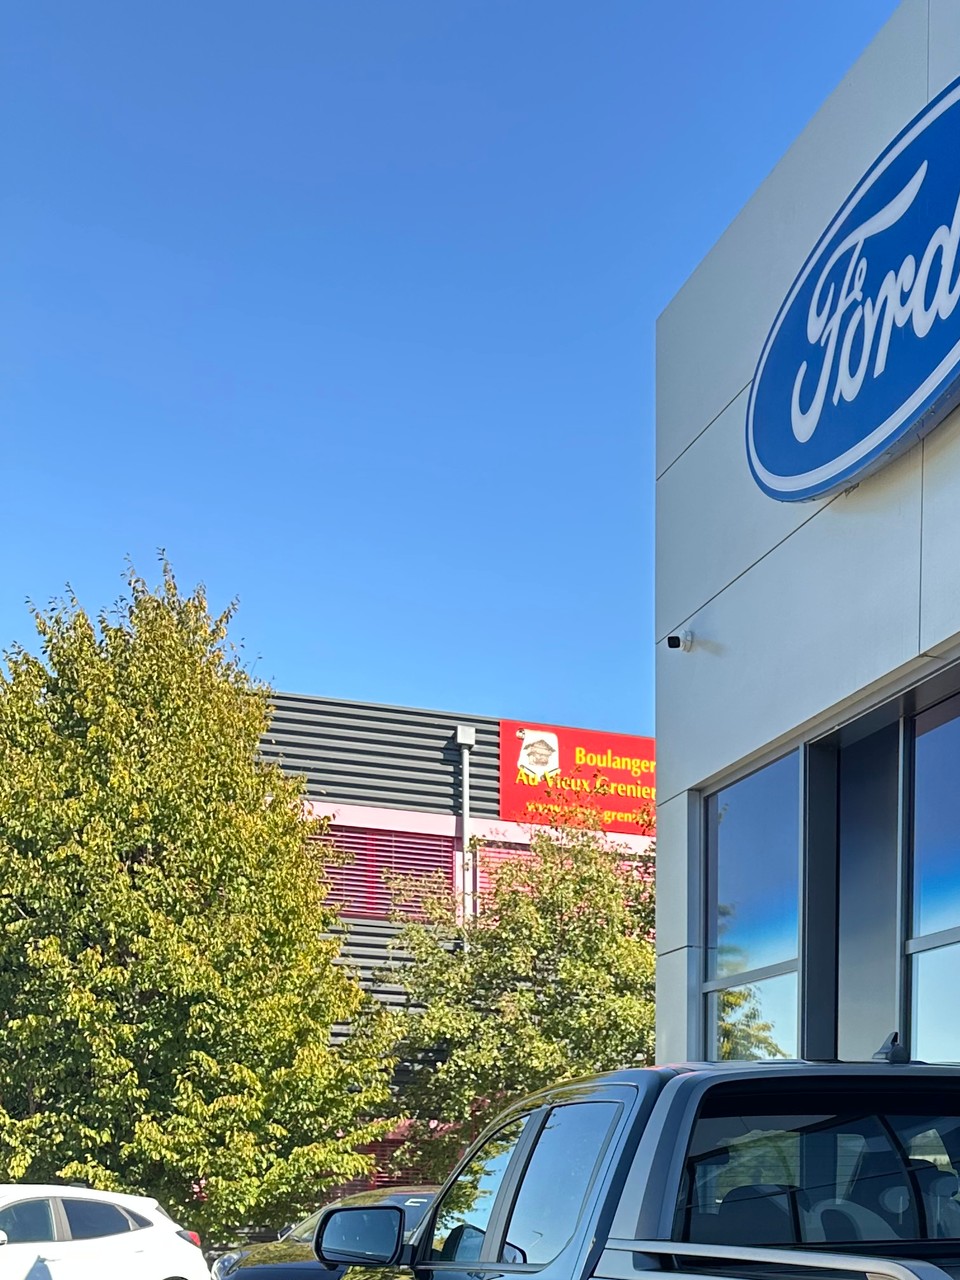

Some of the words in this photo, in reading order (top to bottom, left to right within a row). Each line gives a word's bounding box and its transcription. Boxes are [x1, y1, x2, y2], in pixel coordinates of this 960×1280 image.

[575, 746, 656, 777] Boulanger
[516, 768, 539, 786] Au
[544, 771, 591, 792] Vieux
